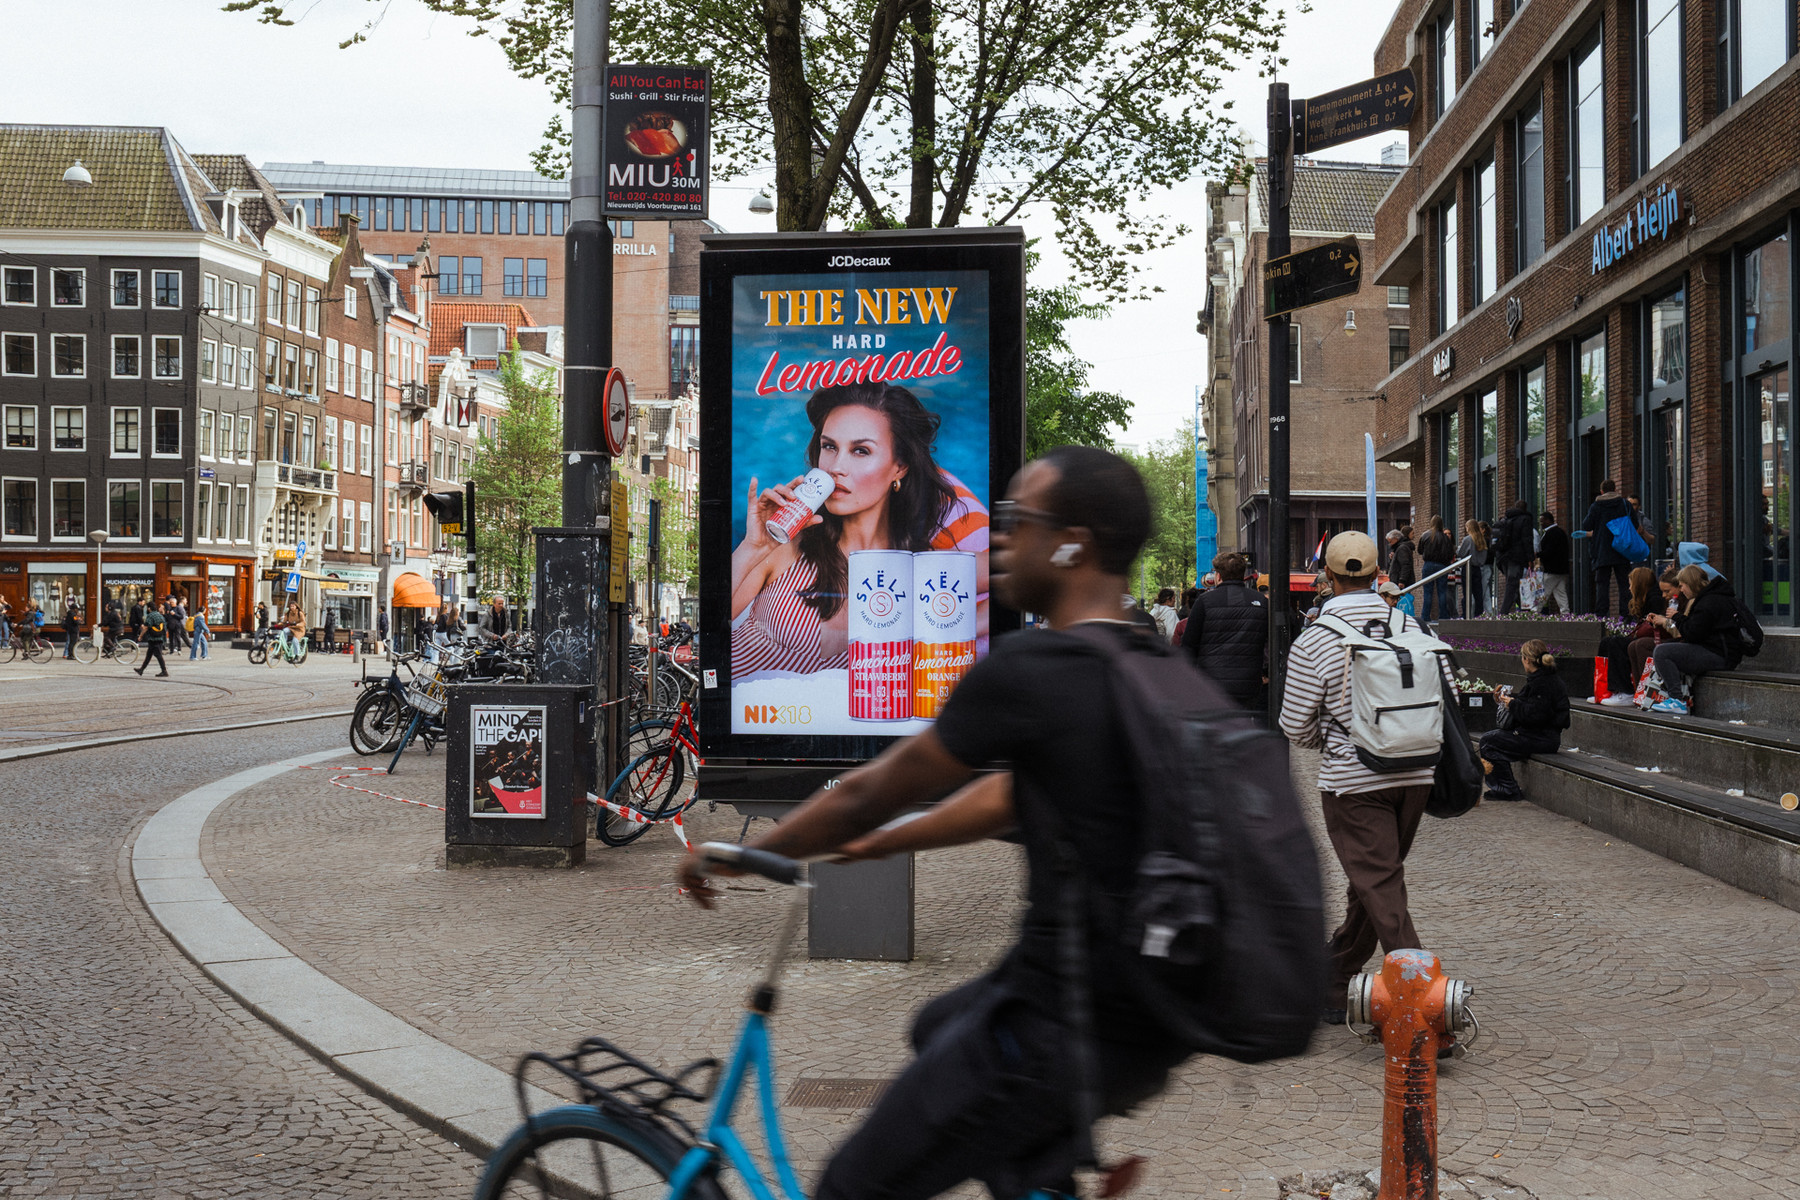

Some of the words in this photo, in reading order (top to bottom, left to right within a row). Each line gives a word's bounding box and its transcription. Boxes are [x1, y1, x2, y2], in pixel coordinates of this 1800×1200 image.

[610, 75, 627, 88] All
[628, 75, 653, 88] You
[656, 76, 681, 88] Can
[684, 77, 705, 90] Eat
[610, 92, 633, 100] Sushi
[639, 92, 658, 100] Grill
[664, 93, 679, 101] Stir
[682, 93, 705, 102] Fried
[1309, 88, 1372, 116] Homomonument
[1384, 82, 1397, 93] 0,4
[1309, 109, 1353, 130] Westerkerk
[1384, 97, 1397, 108] 0,4
[1309, 131, 1328, 144] Anne
[1329, 119, 1368, 138] Frankhuis
[1384, 112, 1396, 122] 0,7
[609, 163, 670, 187] MIU
[672, 177, 700, 188] 30M
[608, 191, 625, 200] Tel.
[674, 193, 686, 202] 80
[689, 194, 702, 203] 80
[1591, 212, 1634, 276] Albert
[1636, 183, 1679, 245] Heijn
[827, 256, 891, 268] JCDecaux
[1329, 248, 1342, 260] 0,2
[760, 289, 844, 326] THE
[854, 286, 958, 325] NEW
[832, 334, 886, 350] HARD
[755, 331, 964, 396] Lemonade
[856, 570, 906, 602] STËLZ
[919, 571, 969, 603] STËLZ
[860, 610, 873, 626] HARD
[873, 610, 902, 628] LEMONADE
[923, 611, 936, 627] HARD
[936, 612, 966, 630] LEMONADE
[851, 649, 912, 670] Lemonade
[914, 649, 974, 671] Lemonade
[854, 672, 908, 682] STRAWBERRY
[926, 672, 961, 682] ORANGE
[876, 686, 886, 698] 63
[938, 686, 950, 697] 63
[478, 713, 521, 727] MIND
[744, 704, 812, 724] NIX18
[478, 728, 504, 742] THE
[504, 728, 542, 742] GAP!
